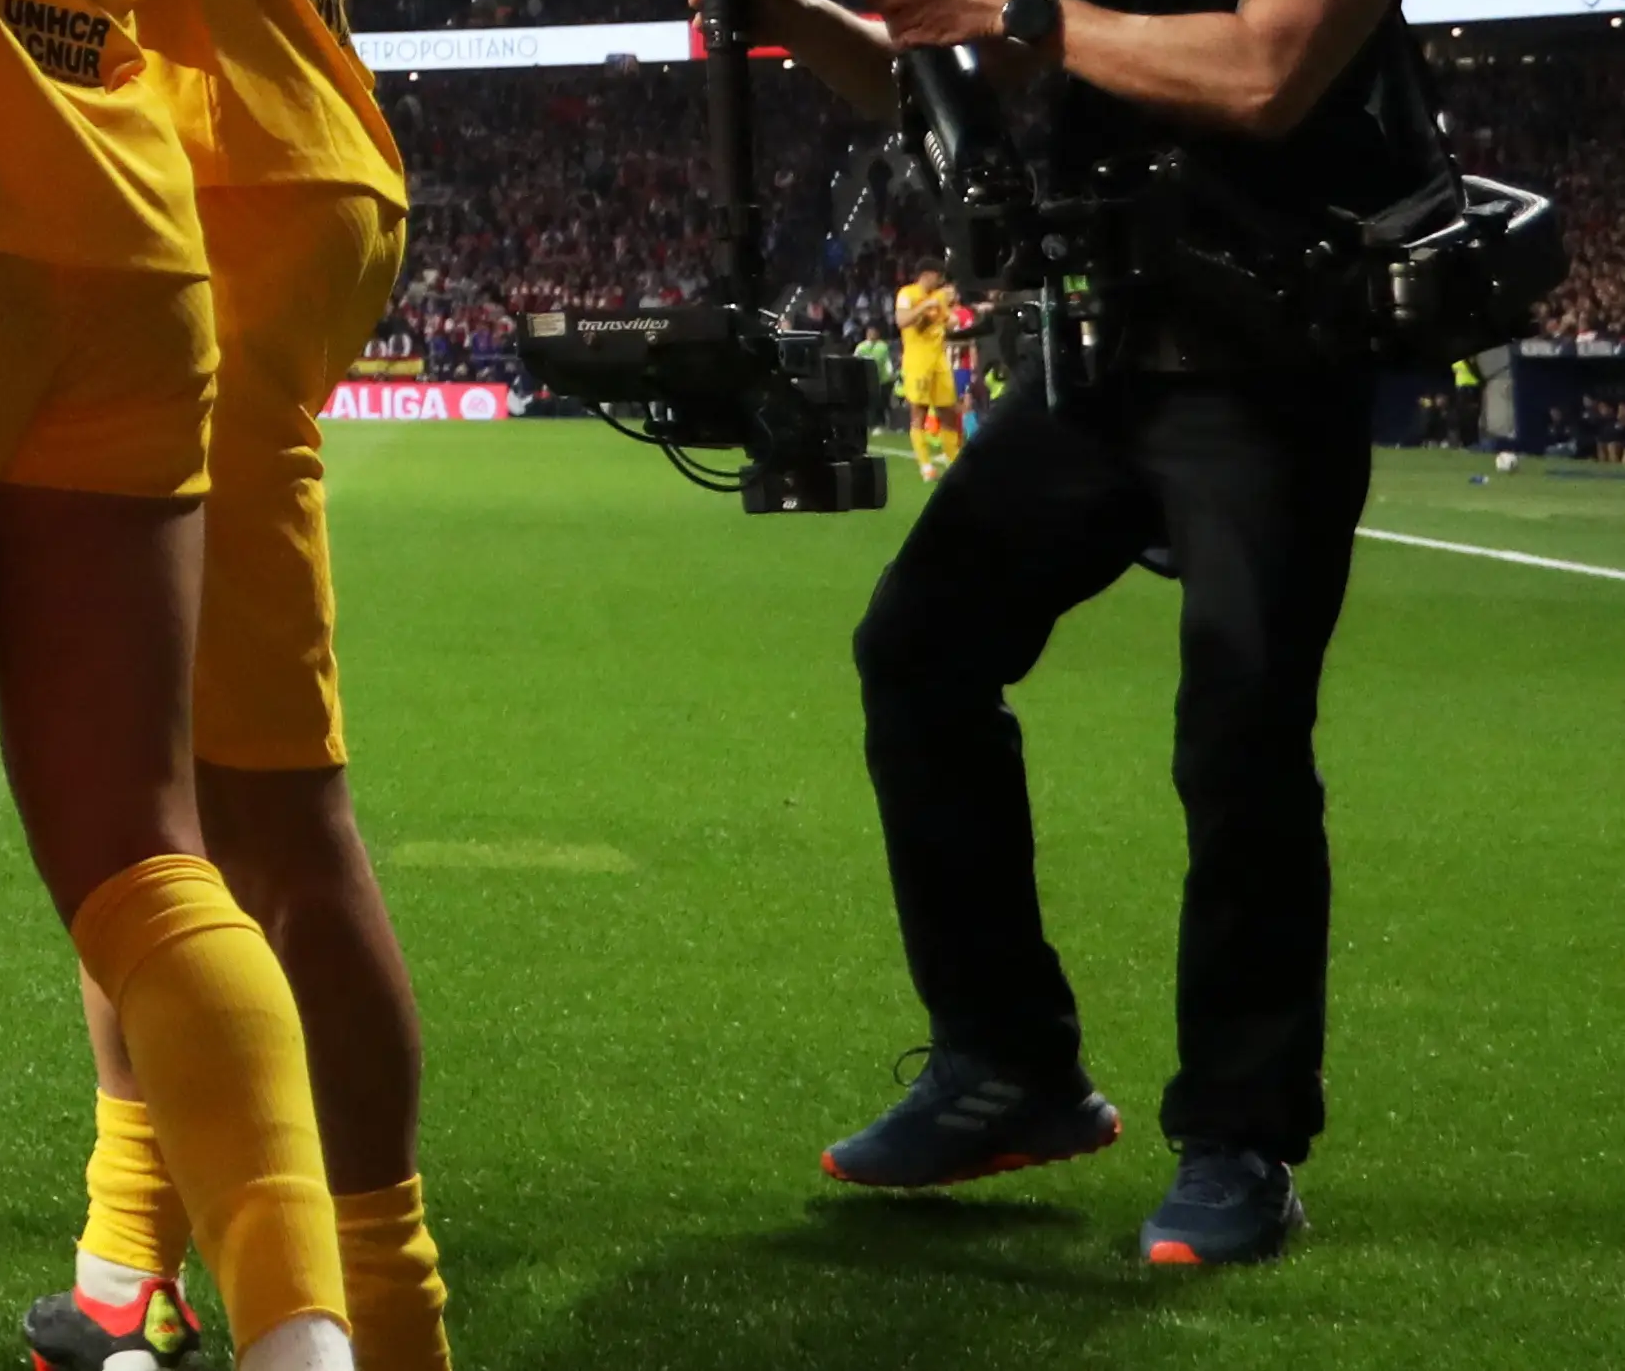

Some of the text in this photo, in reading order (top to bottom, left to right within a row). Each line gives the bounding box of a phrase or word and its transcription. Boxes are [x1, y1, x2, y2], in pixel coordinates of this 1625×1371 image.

[359, 35, 538, 61] ETROPOLITANO
[576, 318, 670, 332] transvideo
[318, 385, 449, 419] ALIGA
